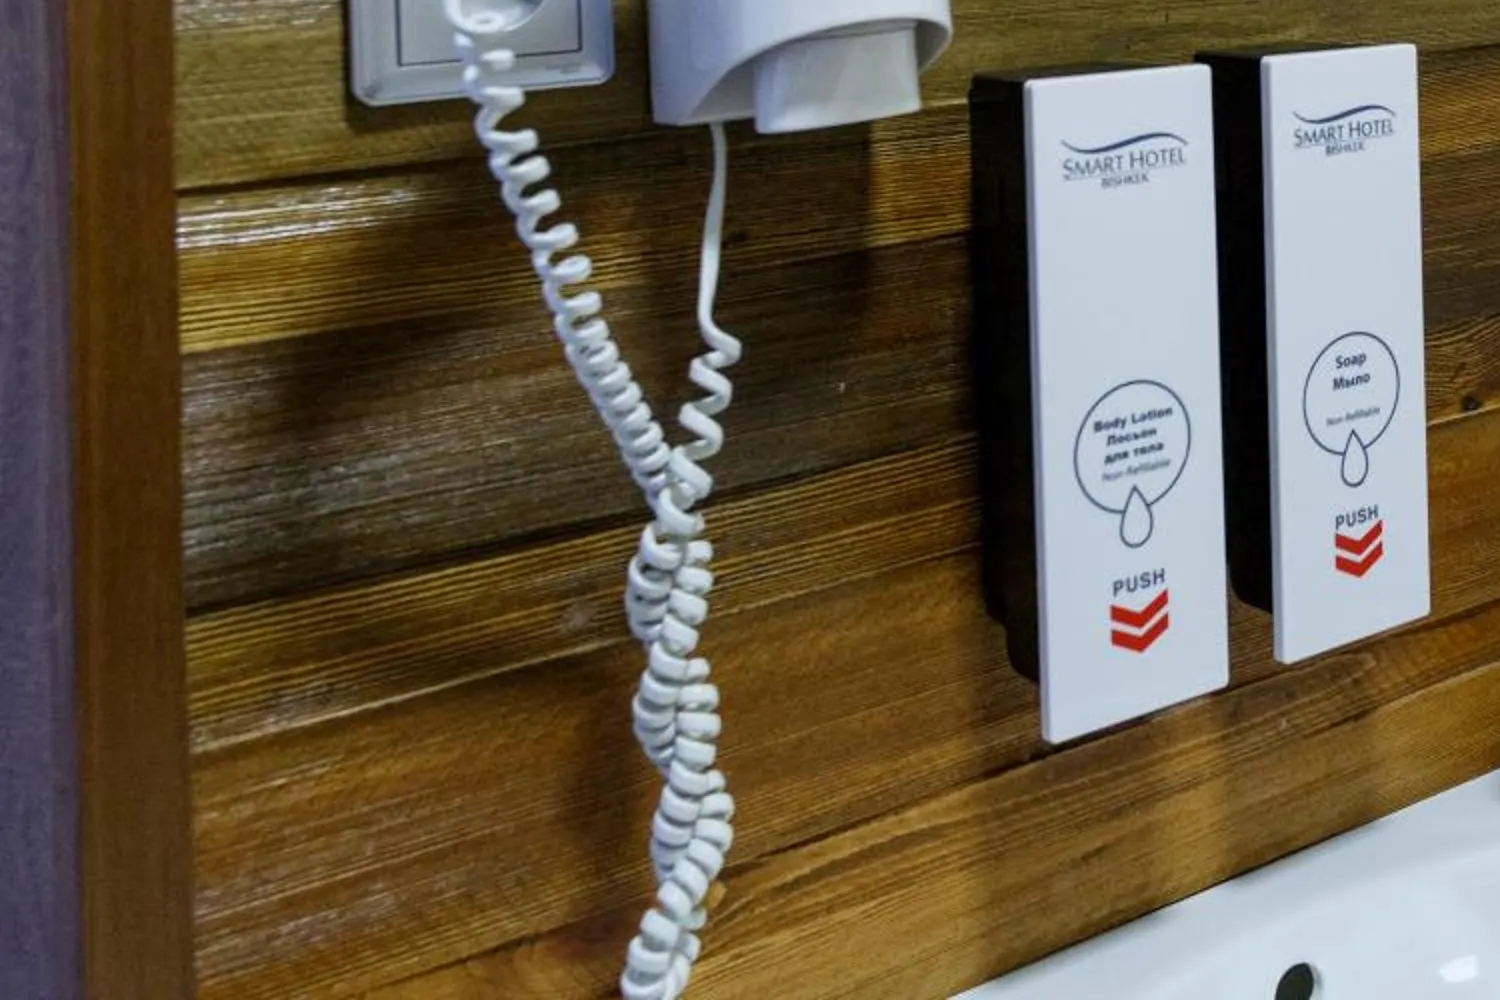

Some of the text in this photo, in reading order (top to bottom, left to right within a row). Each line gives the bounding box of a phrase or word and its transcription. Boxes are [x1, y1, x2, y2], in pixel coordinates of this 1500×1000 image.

[1294, 119, 1393, 146] SMART HOTEL
[1063, 147, 1186, 177] SMART HOTEL
[1335, 353, 1367, 369] Soap
[1332, 373, 1371, 392] Мыло
[1093, 407, 1173, 433] Body Lotion
[1106, 428, 1157, 447] Лосьон
[1104, 442, 1164, 465] для тела
[1335, 504, 1379, 530] PUSH
[1112, 568, 1166, 597] PUSH
